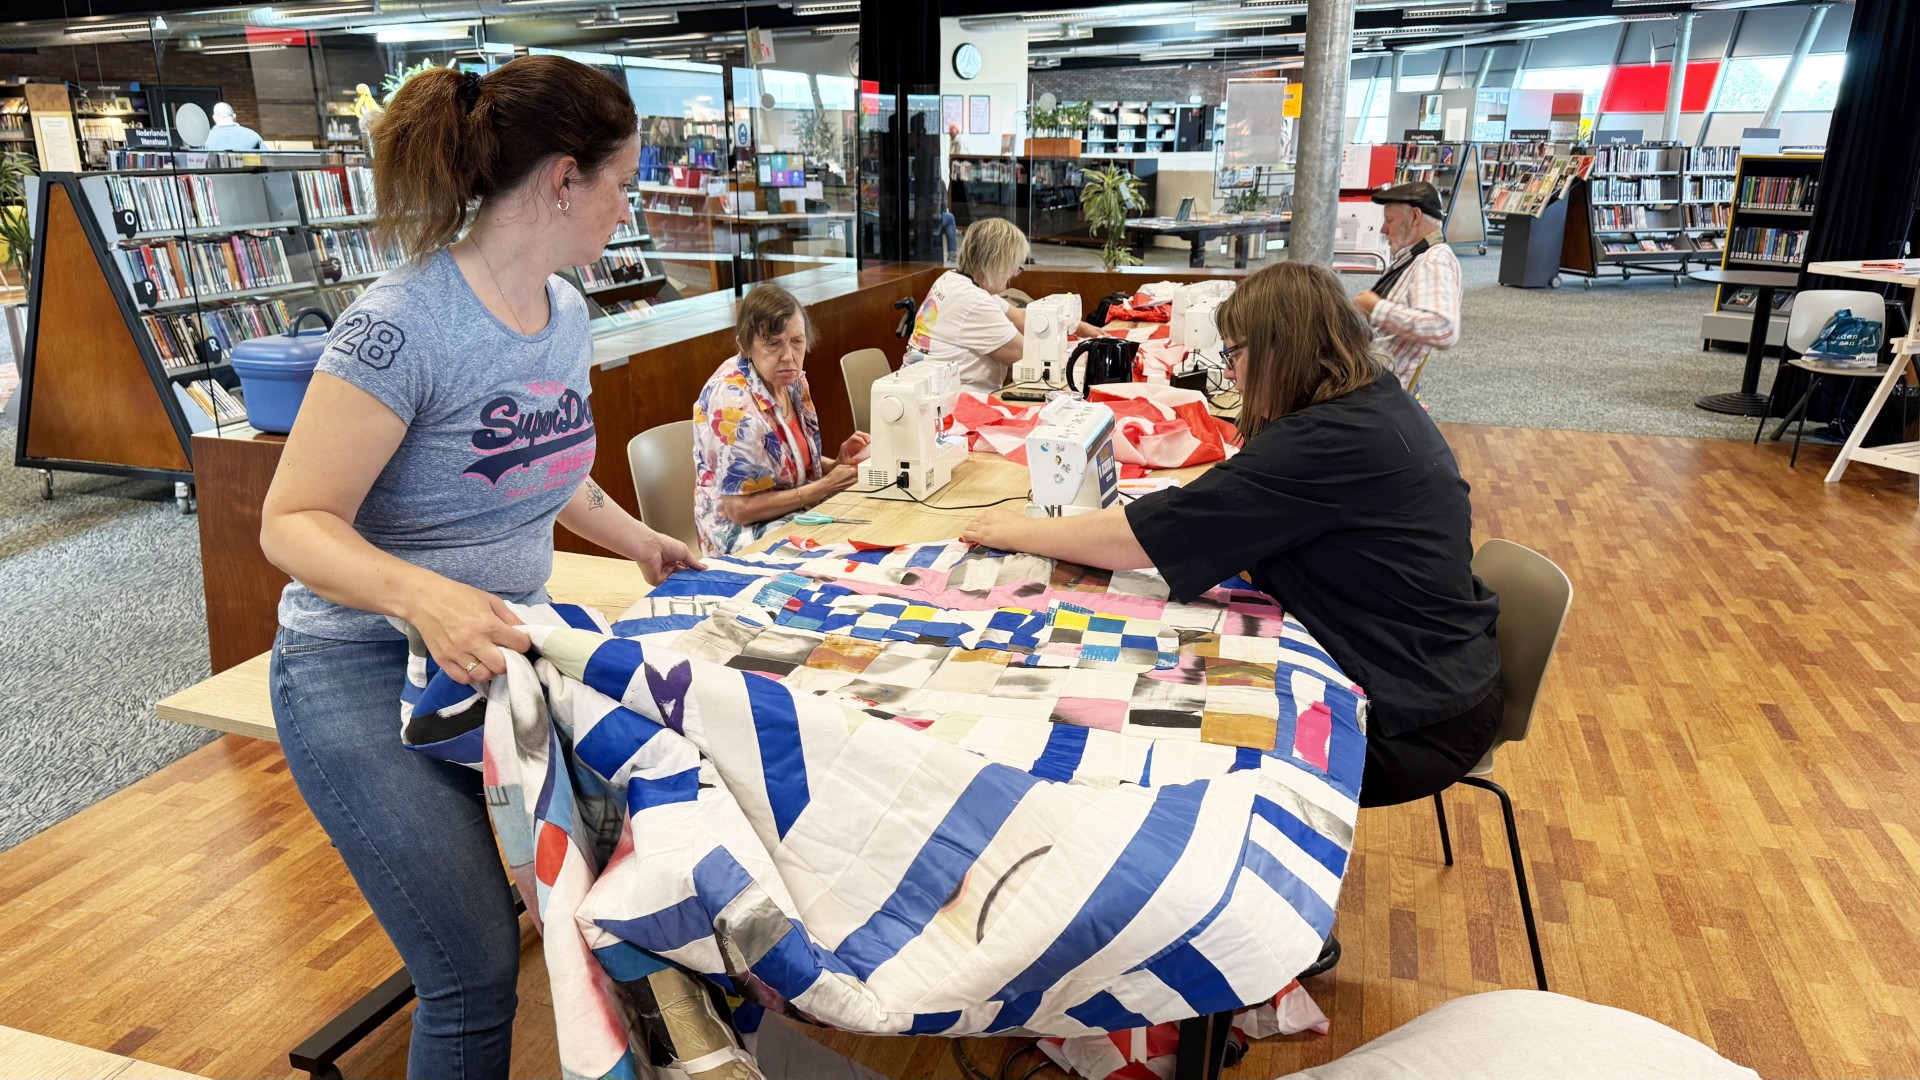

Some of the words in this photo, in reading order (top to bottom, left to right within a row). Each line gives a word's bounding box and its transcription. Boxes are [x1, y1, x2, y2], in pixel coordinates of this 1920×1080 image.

[1611, 135, 1626, 144] Engels
[124, 211, 135, 226] O
[145, 281, 154, 296] P
[208, 338, 219, 352] R
[332, 313, 405, 370] 28
[471, 388, 594, 450] SuperDr
